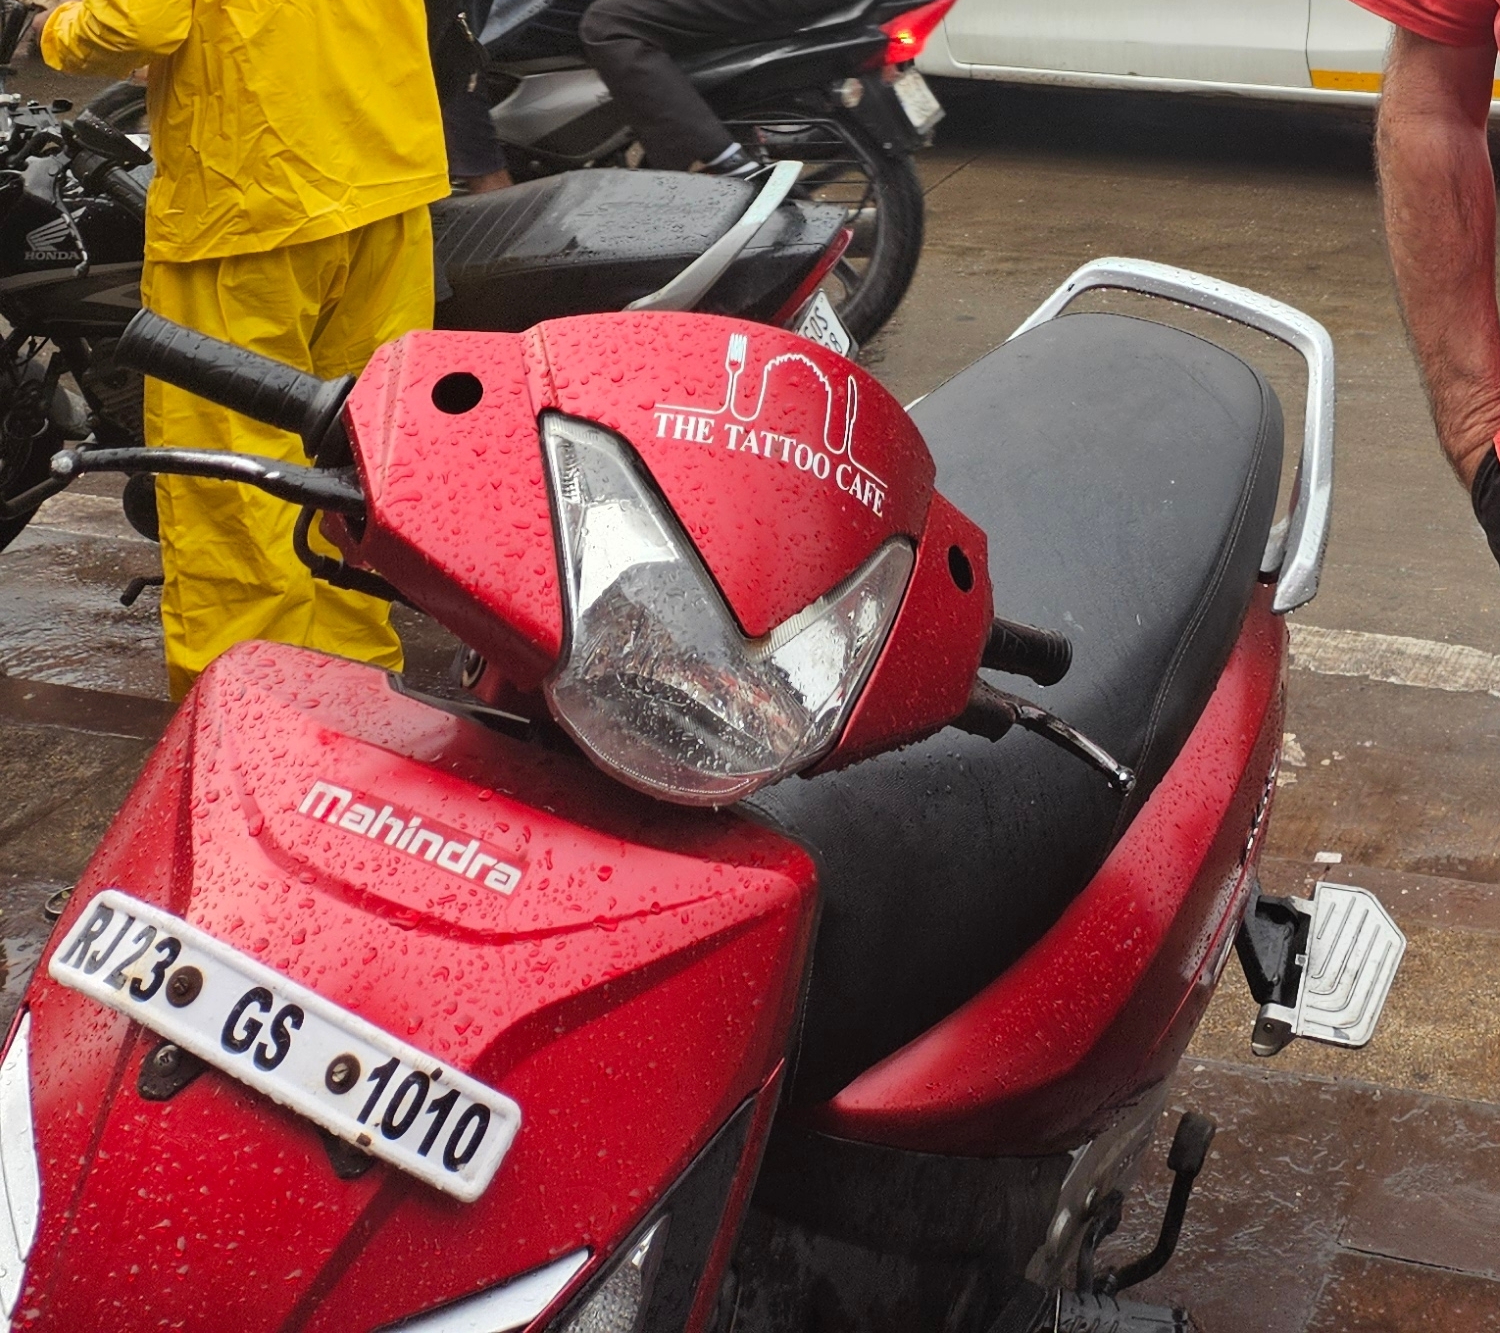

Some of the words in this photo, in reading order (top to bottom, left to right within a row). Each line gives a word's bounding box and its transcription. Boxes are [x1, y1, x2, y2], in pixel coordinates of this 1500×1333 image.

[24, 251, 79, 261] HONDA
[653, 412, 715, 444] THE
[724, 423, 831, 480] TATTOO
[835, 463, 885, 518] CAFE
[298, 780, 522, 896] Mahindra
[59, 902, 182, 1003] RJ23
[220, 986, 305, 1072] GS
[356, 1056, 491, 1173] 1010
